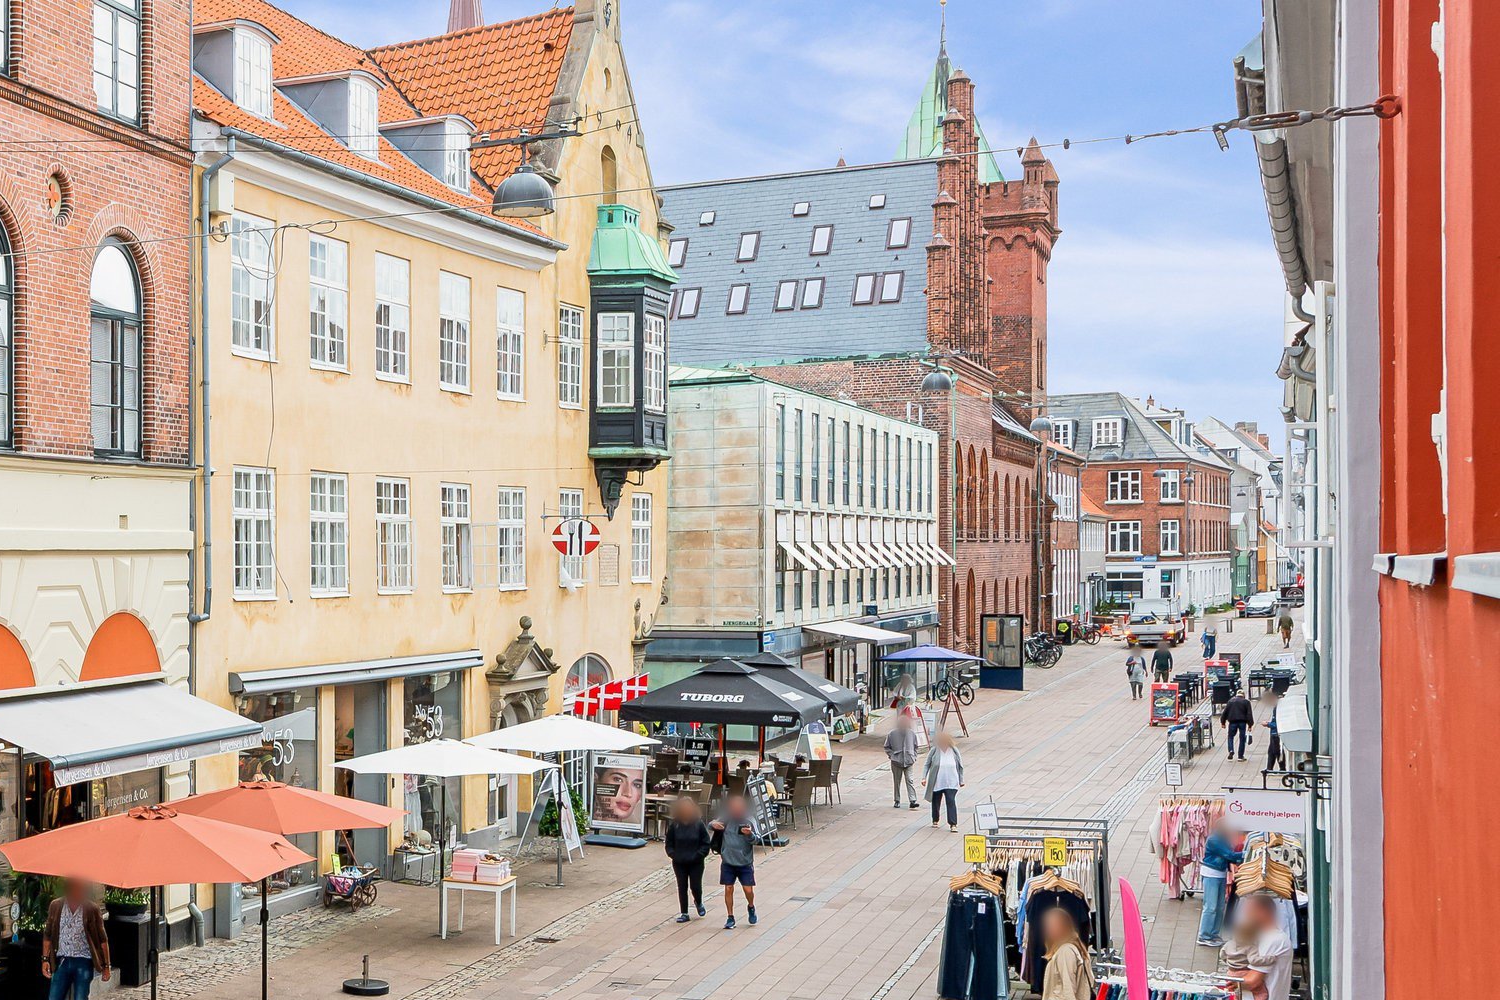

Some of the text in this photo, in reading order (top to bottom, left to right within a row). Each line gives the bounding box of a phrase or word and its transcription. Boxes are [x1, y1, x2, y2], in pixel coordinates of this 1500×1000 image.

[680, 692, 745, 703] TUBORG
[426, 704, 443, 739] 53
[272, 728, 295, 766] 53
[1244, 809, 1300, 819] Mødrehjælpen
